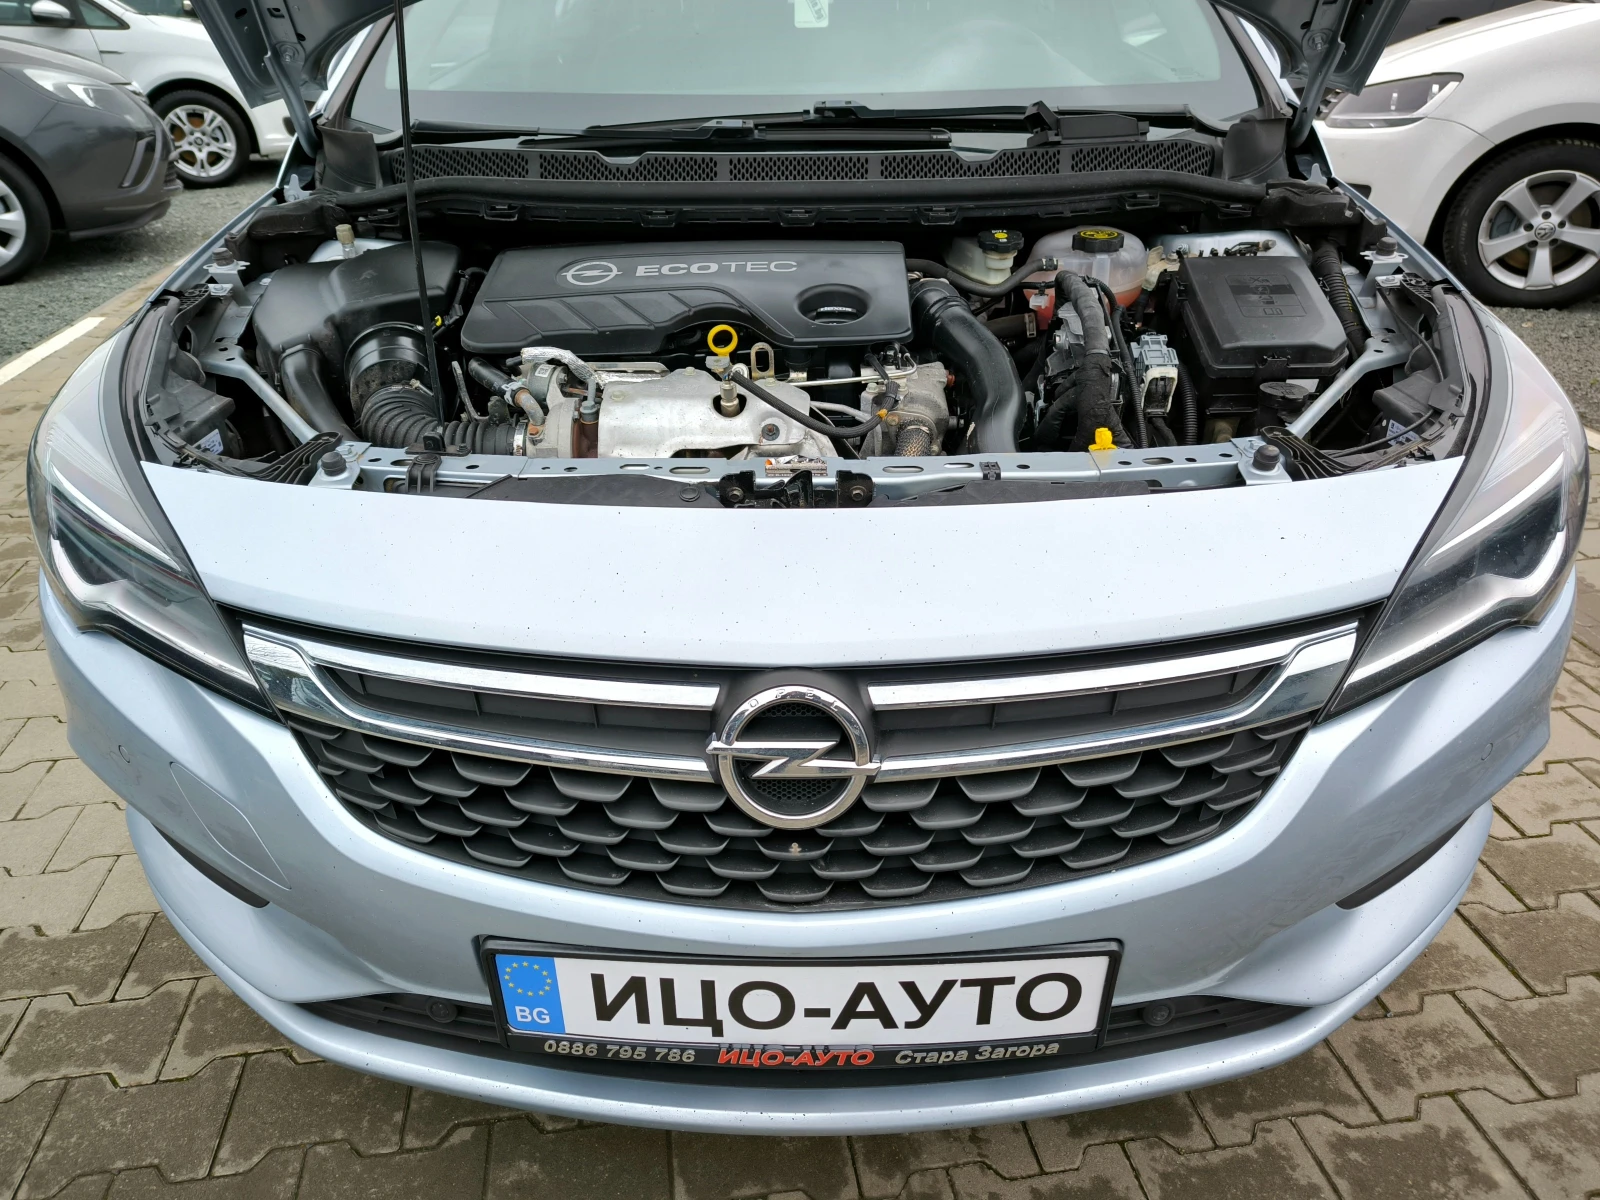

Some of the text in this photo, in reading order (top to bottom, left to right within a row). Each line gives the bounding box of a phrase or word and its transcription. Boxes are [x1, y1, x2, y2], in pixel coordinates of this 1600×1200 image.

[636, 261, 797, 277] ECOTEC
[749, 689, 838, 711] OPEL
[516, 1006, 551, 1024] BG
[591, 973, 1082, 1036] ИЦО-АУТО
[544, 1041, 695, 1062] 0886 795 786
[717, 1046, 874, 1066] ИЦО-АУТО
[896, 1041, 1059, 1066] Стара Загора
